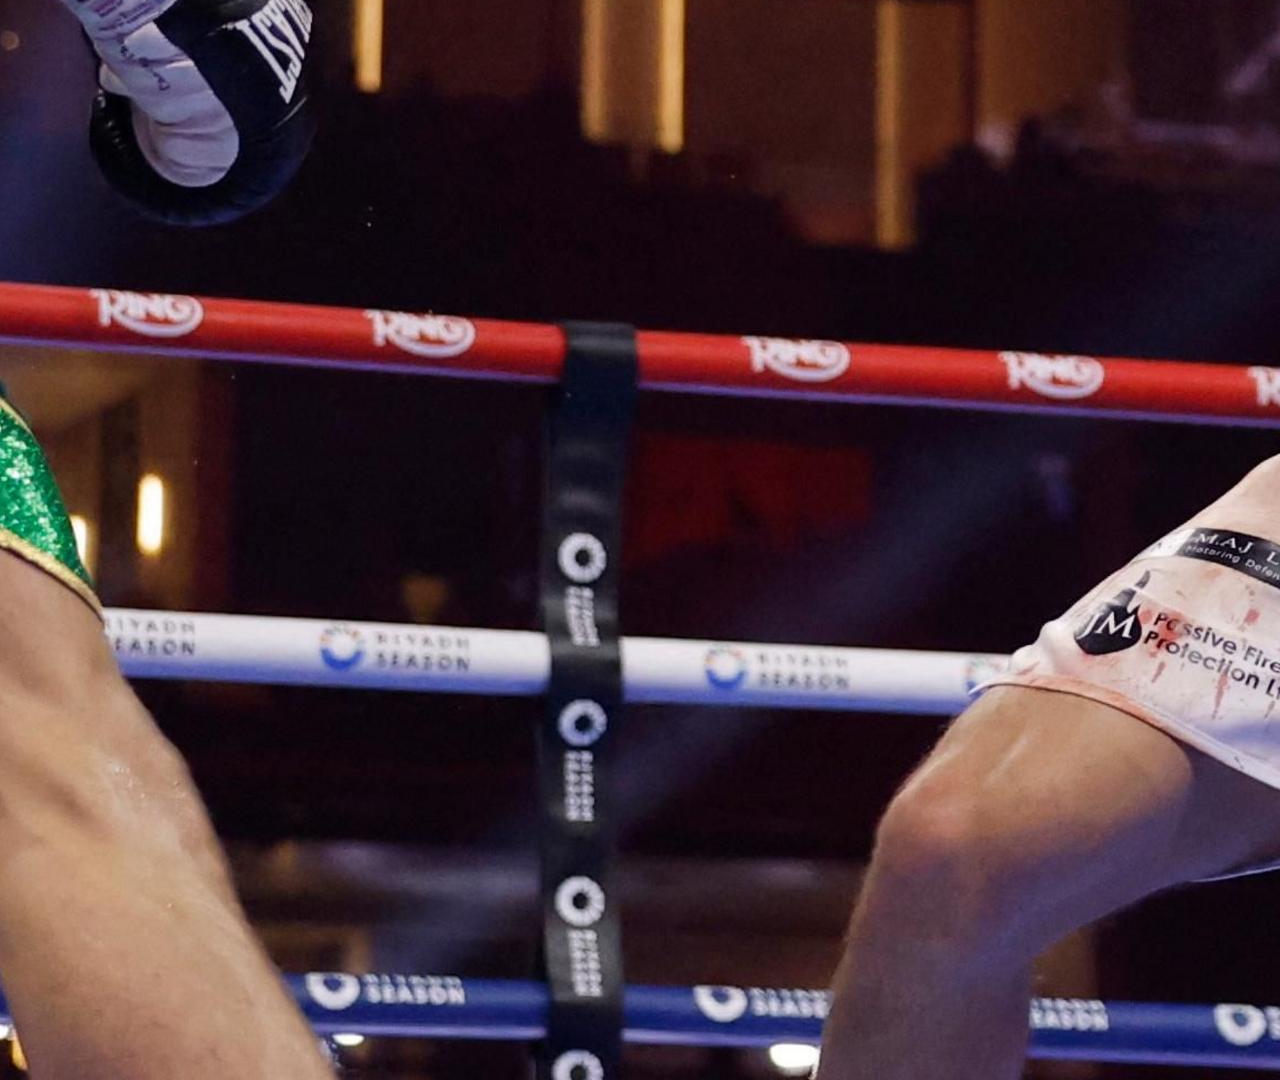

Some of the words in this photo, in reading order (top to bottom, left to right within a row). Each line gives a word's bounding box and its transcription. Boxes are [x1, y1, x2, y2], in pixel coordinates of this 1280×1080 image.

[89, 287, 203, 338] RING
[365, 309, 475, 358] RING
[739, 334, 850, 382] RING
[375, 631, 470, 650] RIYADH
[375, 651, 470, 672] SEASON
[1142, 630, 1260, 690] Protection
[757, 671, 850, 691] SEASON
[365, 983, 466, 1005] SEASON
